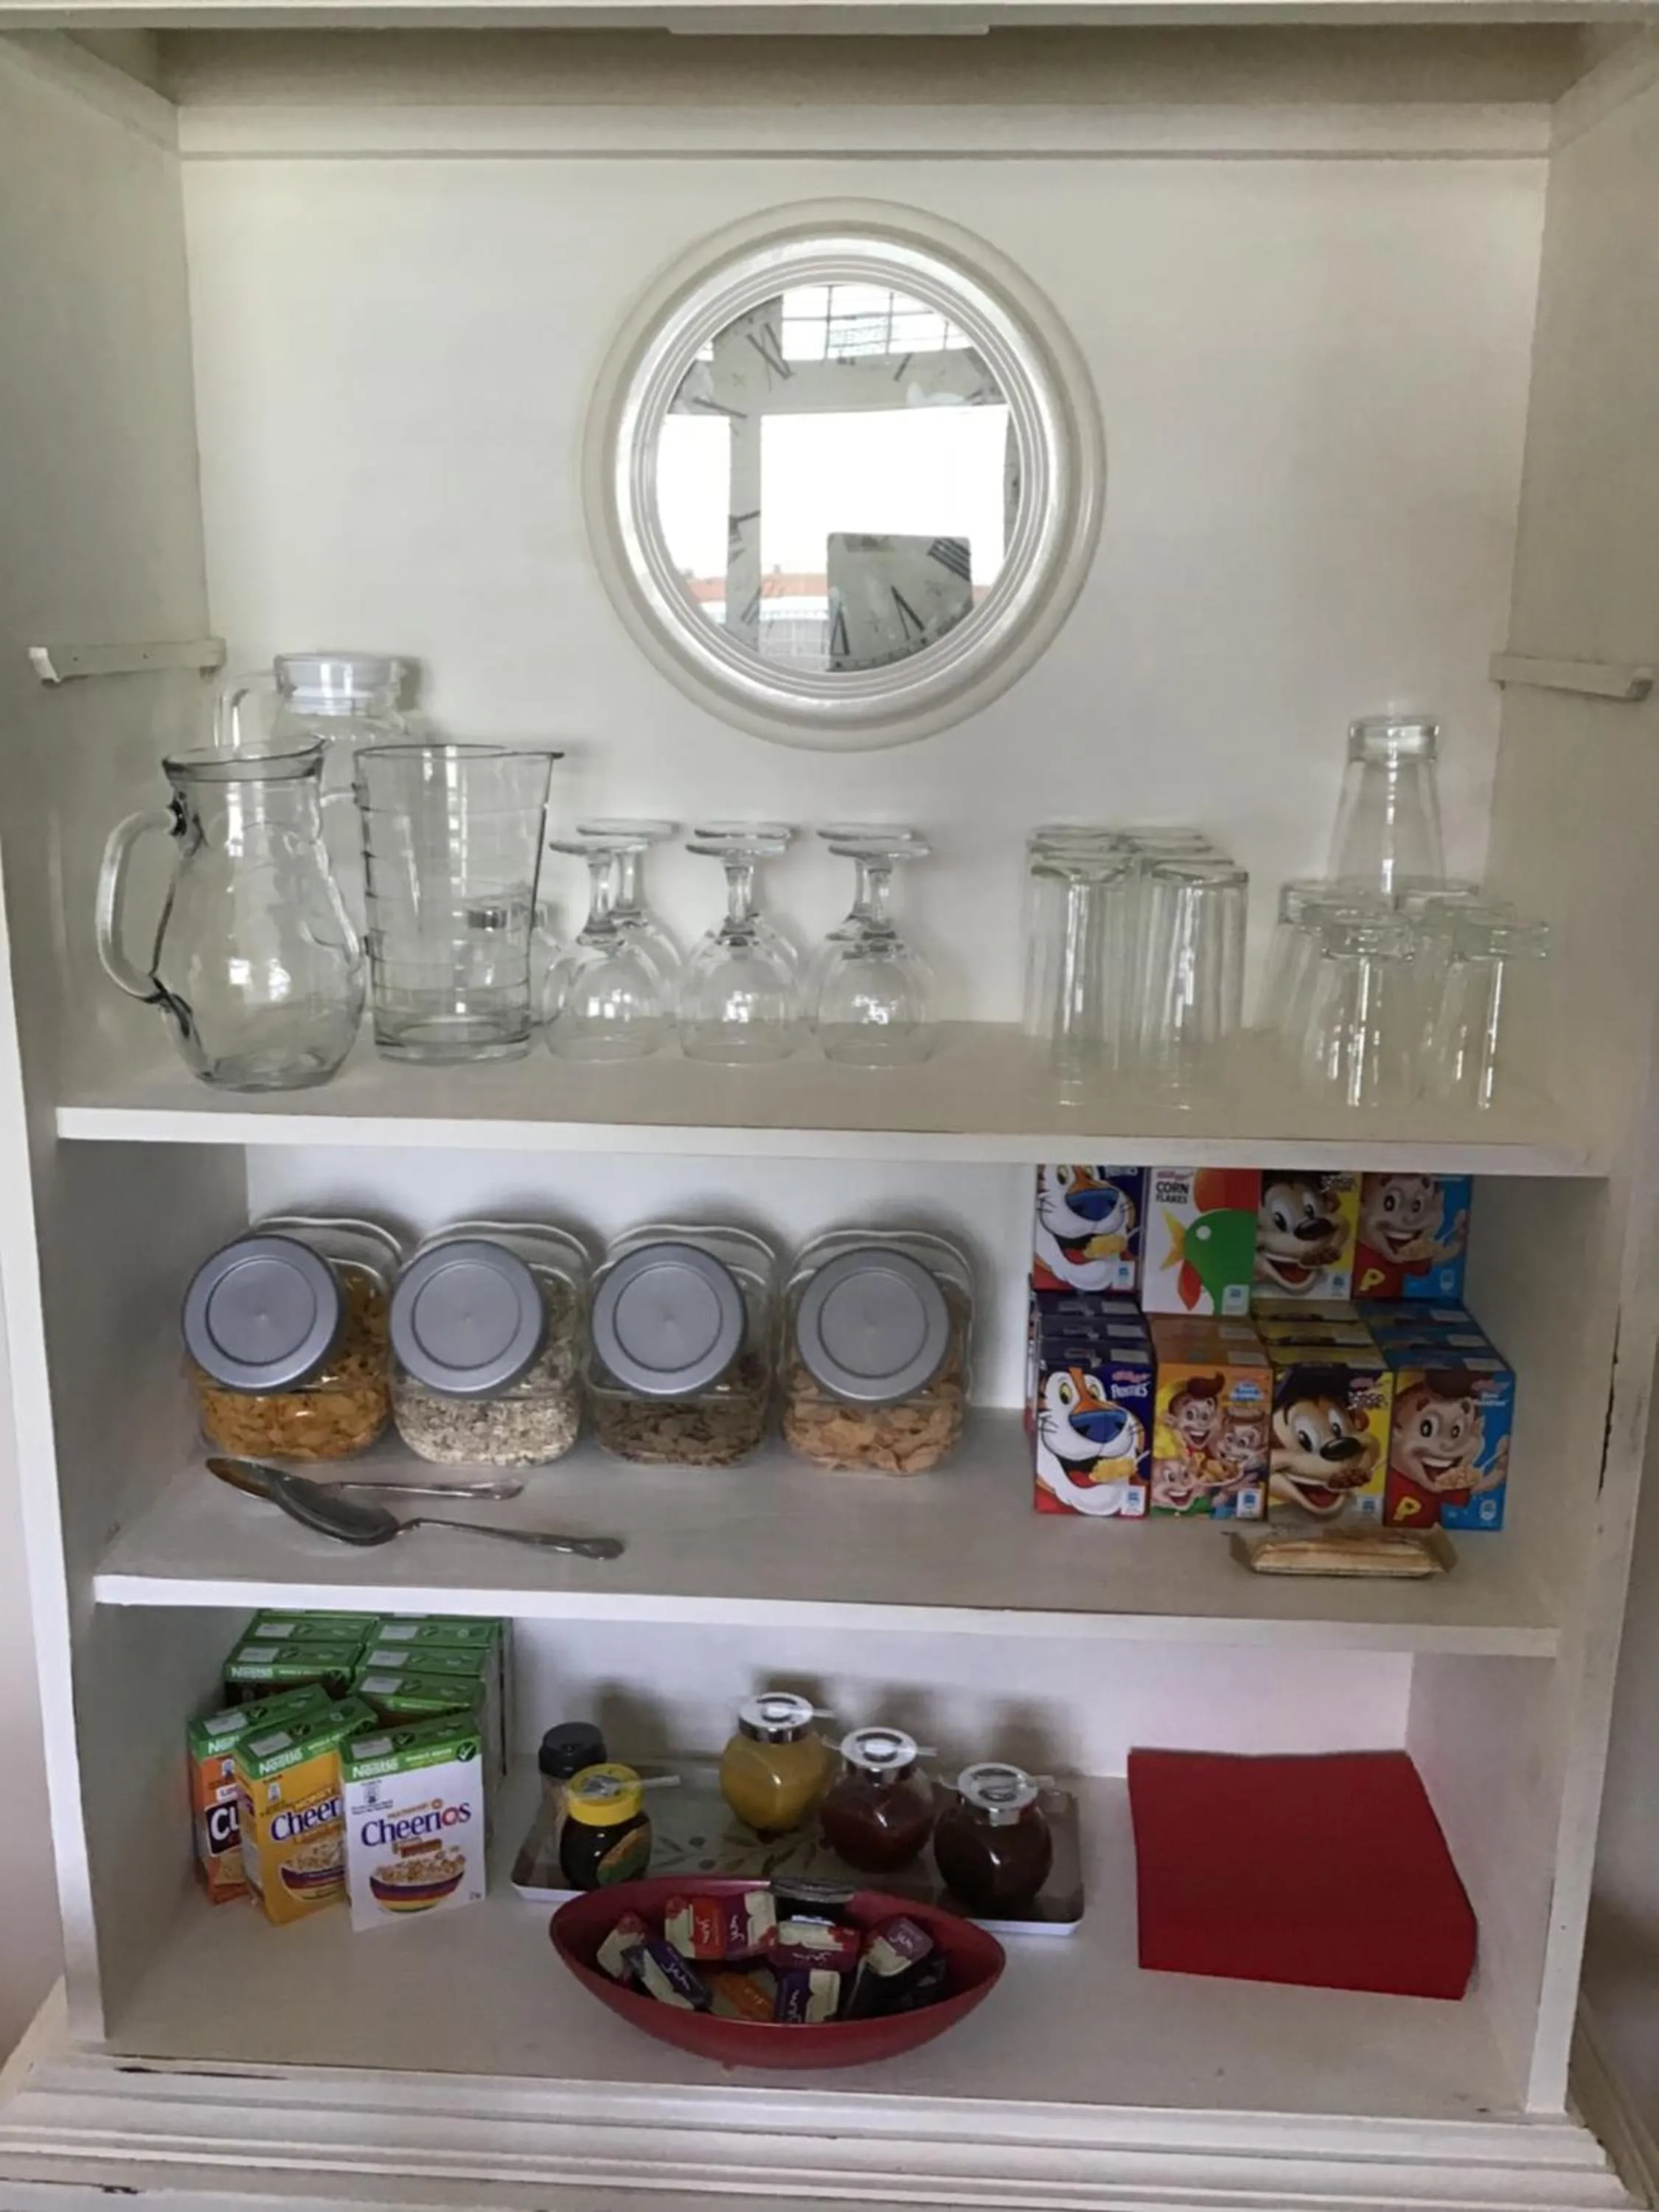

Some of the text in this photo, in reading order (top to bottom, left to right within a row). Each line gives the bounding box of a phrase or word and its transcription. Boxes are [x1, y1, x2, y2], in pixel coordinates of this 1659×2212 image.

[1155, 1180, 1189, 1194] CORN
[1393, 1496, 1418, 1520] P
[271, 1796, 342, 1841] Cheer
[361, 1802, 473, 1847] Cheerios
